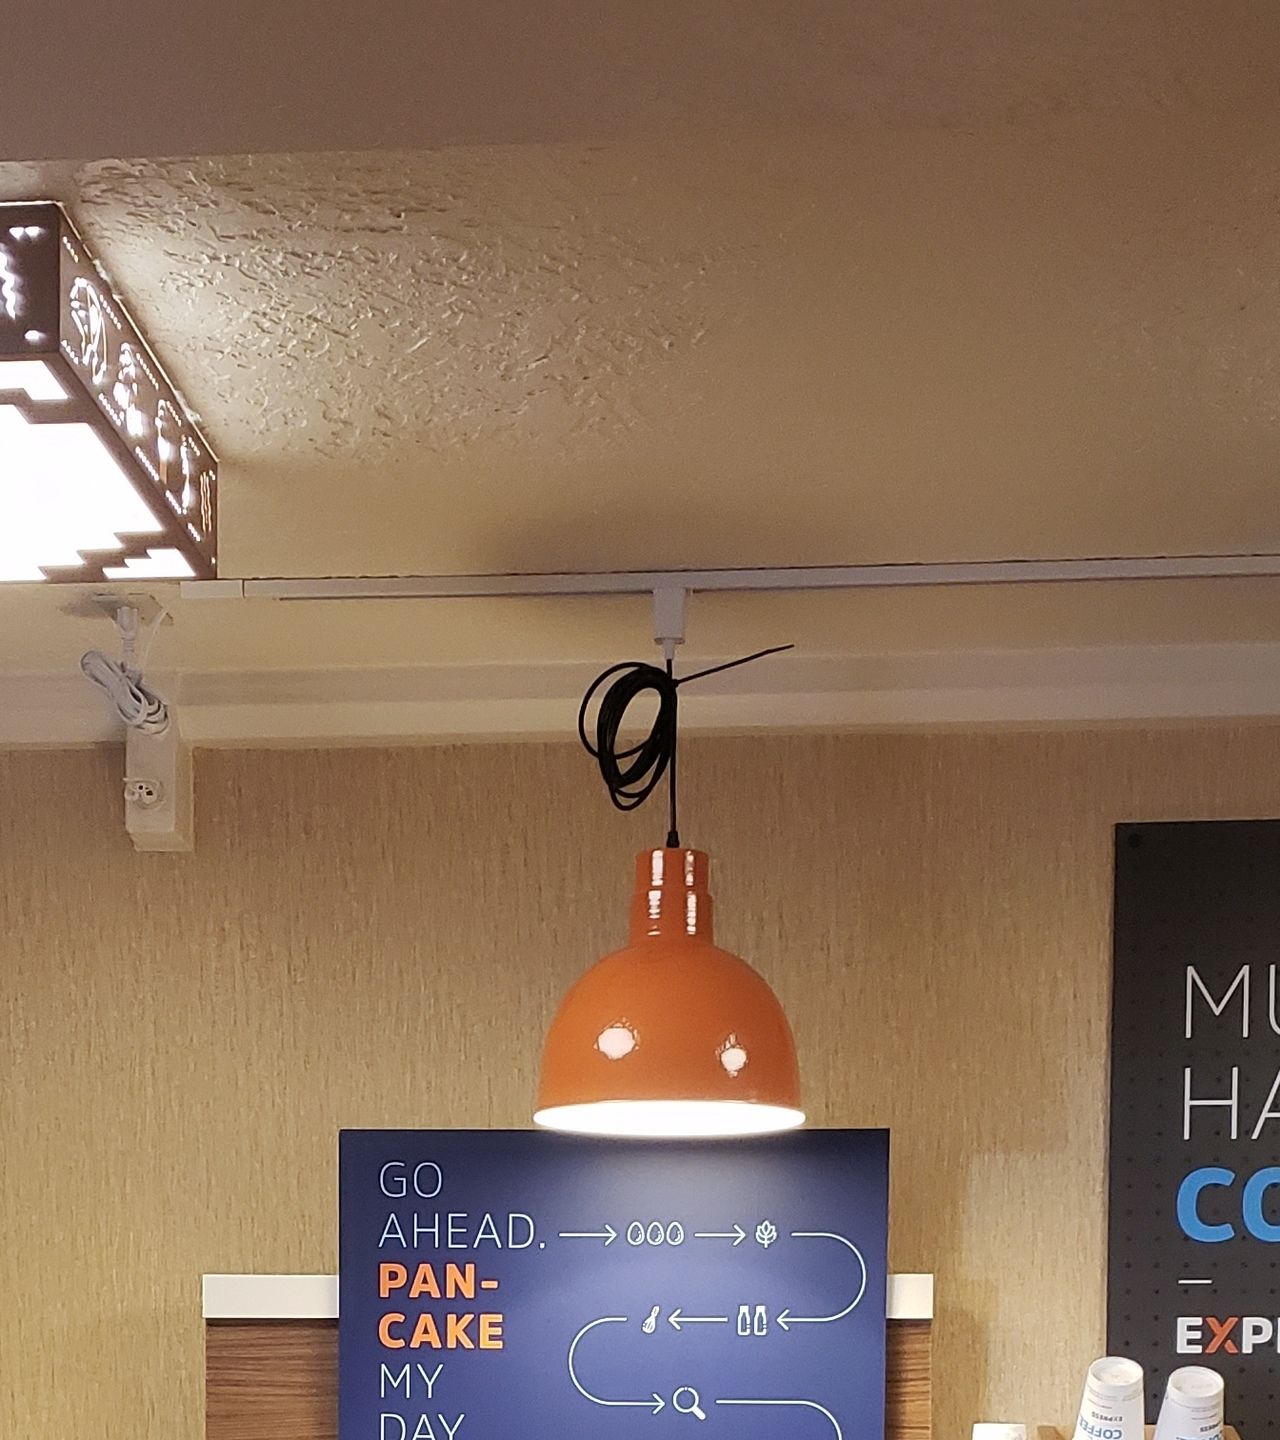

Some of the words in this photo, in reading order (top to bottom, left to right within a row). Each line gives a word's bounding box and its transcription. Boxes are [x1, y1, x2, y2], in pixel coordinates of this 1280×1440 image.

[378, 1160, 443, 1198] GO
[378, 1212, 547, 1250] AHEAD.
[378, 1263, 500, 1299] PAN-
[378, 1313, 505, 1350] CAKE
[379, 1363, 444, 1400] MY
